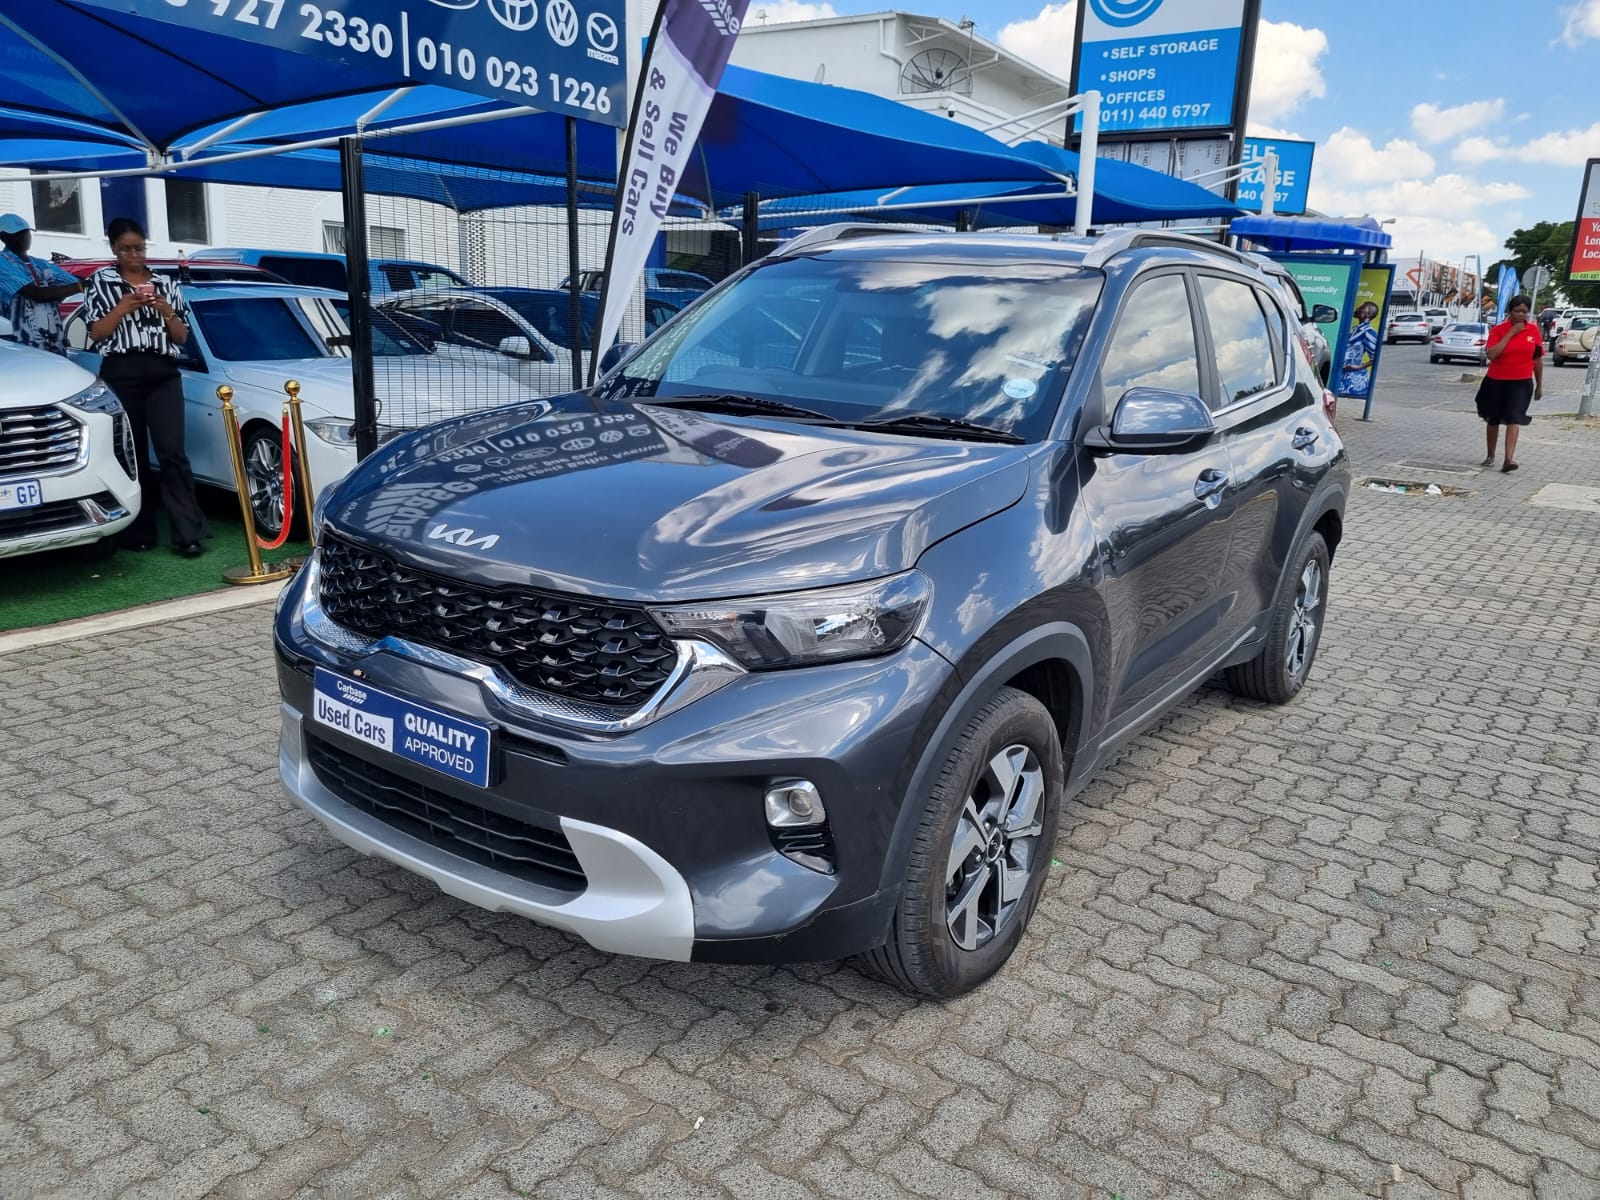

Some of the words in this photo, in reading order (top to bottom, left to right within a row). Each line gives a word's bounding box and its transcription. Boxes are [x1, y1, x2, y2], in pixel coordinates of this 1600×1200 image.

[300, 3, 393, 58] 2330
[417, 37, 476, 81] 010
[486, 56, 539, 97] 023
[549, 73, 611, 114] 1226
[1110, 45, 1146, 60] SELF
[1149, 38, 1219, 56] STORAGE
[650, 67, 666, 91] &
[1108, 68, 1156, 83] SHOPS
[1106, 89, 1166, 104] OFFICES
[1138, 106, 1167, 119] 440
[1172, 103, 1211, 118] 6797
[637, 101, 661, 161] Sell
[663, 111, 688, 157] We
[1241, 144, 1276, 160] ELF
[621, 168, 649, 237] Cars
[650, 163, 676, 221] Buy
[16, 485, 37, 505] GP
[336, 680, 368, 701] Carbase
[318, 698, 350, 729] Used
[354, 712, 386, 745] Cars
[404, 712, 476, 752] QUALITY
[404, 736, 474, 774] APPROVED
